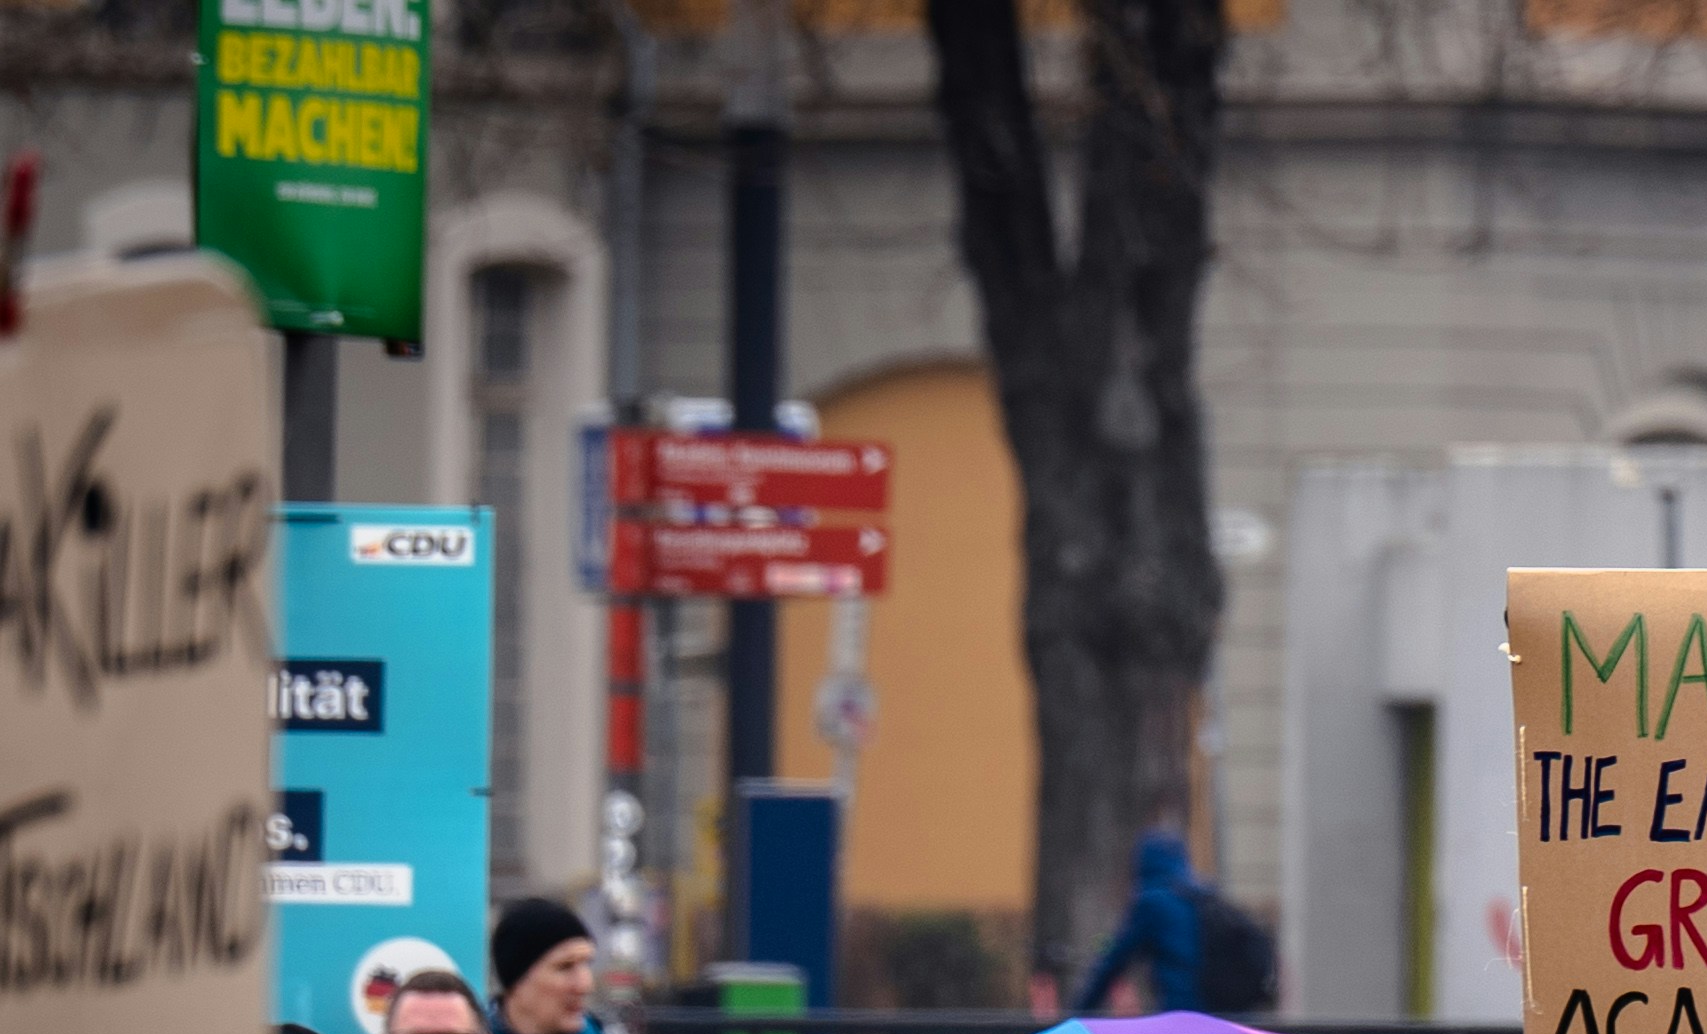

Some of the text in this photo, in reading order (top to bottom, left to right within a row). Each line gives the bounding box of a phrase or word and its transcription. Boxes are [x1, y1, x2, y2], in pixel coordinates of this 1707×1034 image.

[218, 31, 421, 98] BEZAHLBAR
[217, 91, 420, 173] MACHEN!
[382, 530, 468, 558] CDU
[1533, 750, 1622, 842] THE
